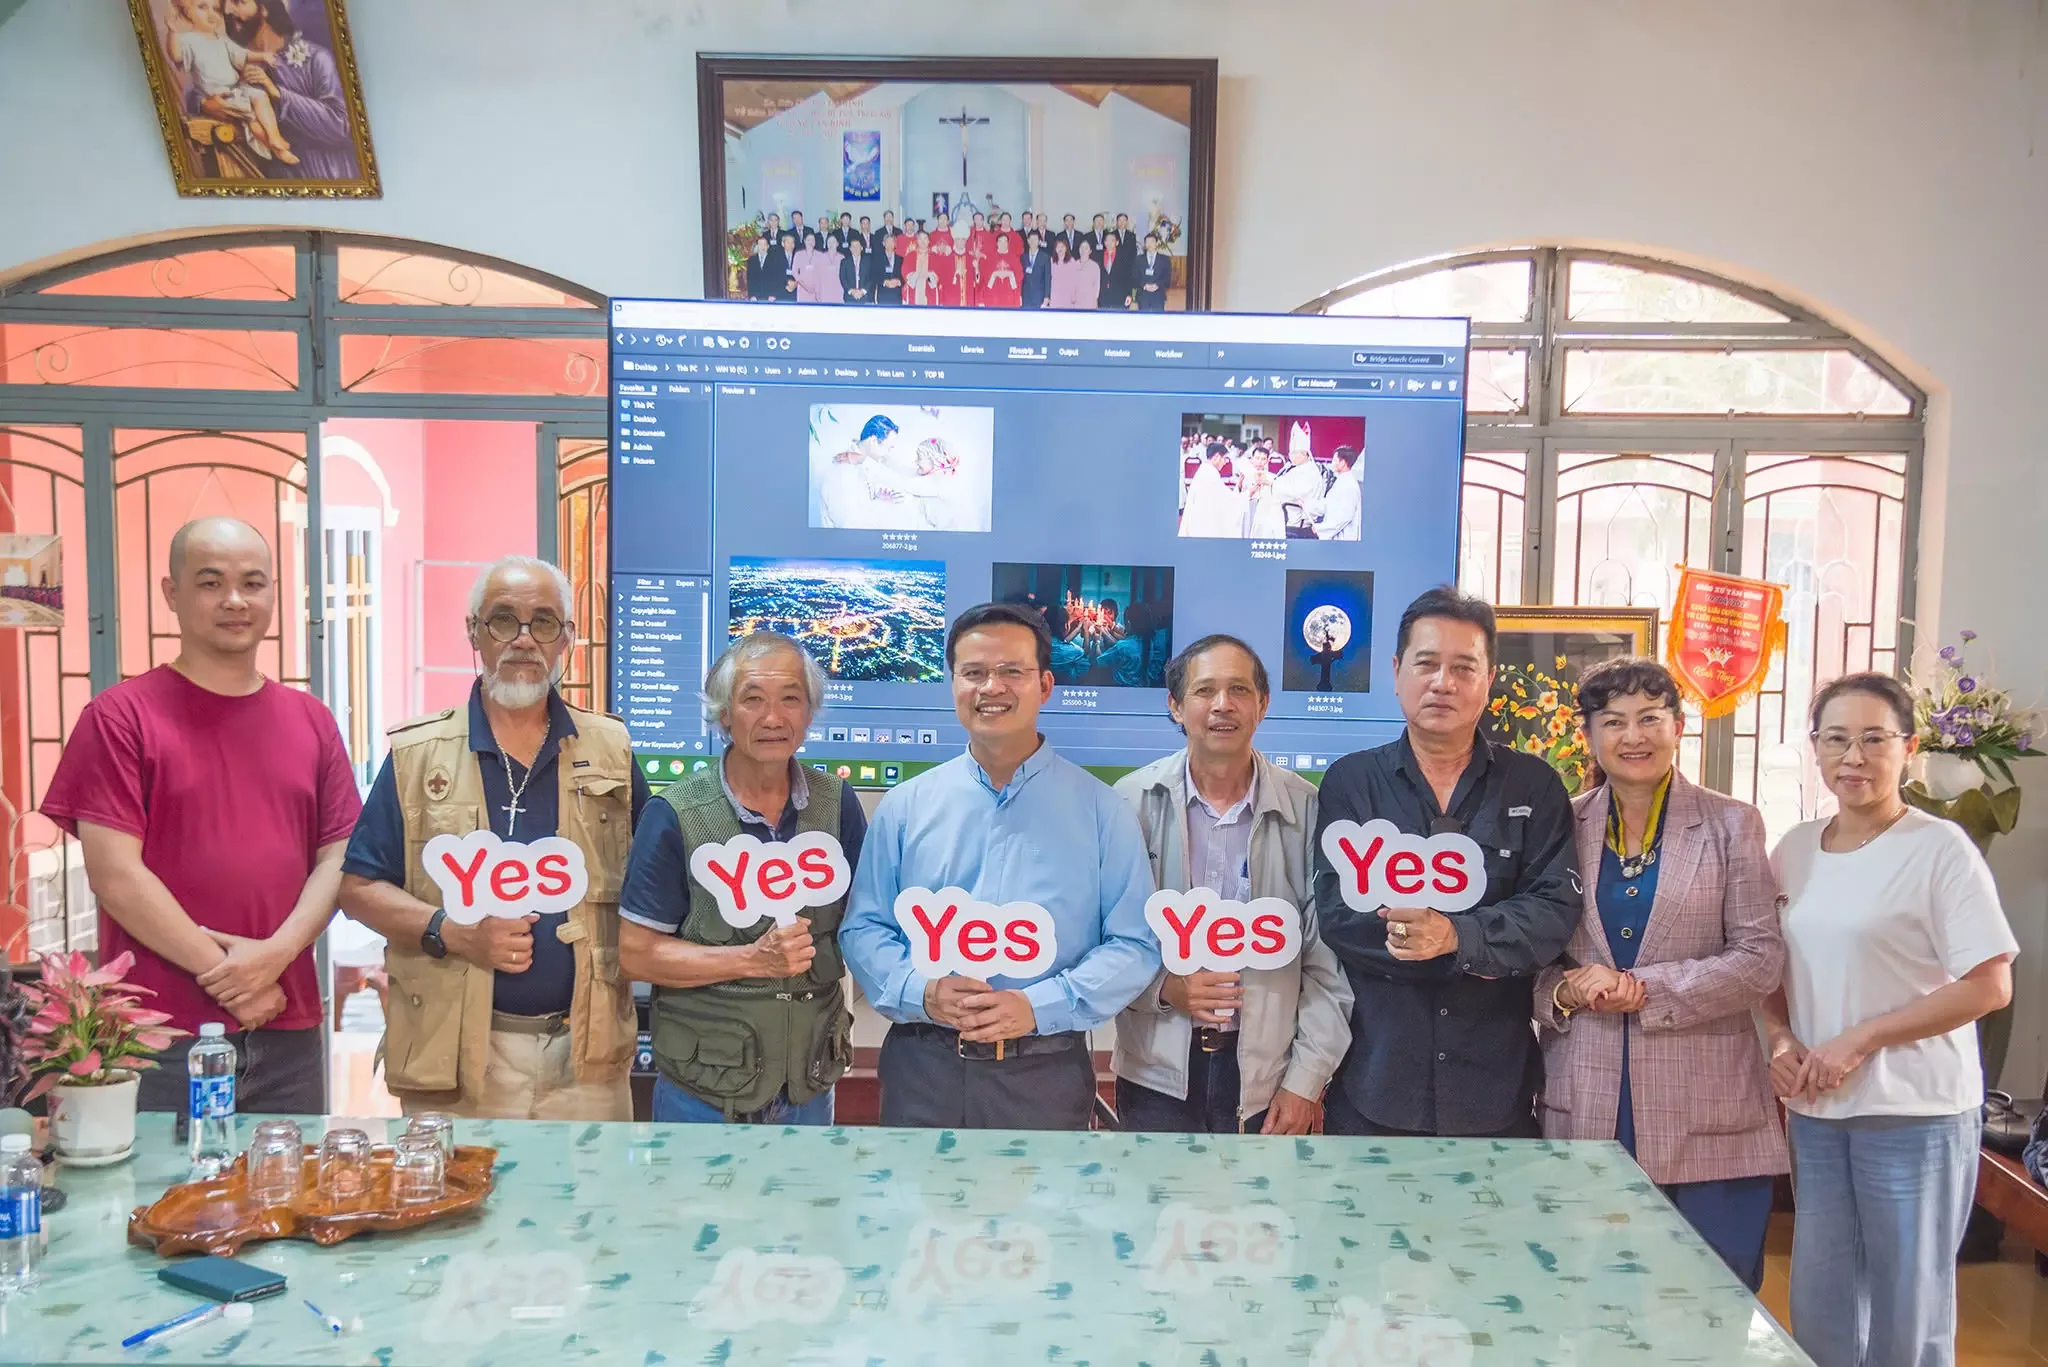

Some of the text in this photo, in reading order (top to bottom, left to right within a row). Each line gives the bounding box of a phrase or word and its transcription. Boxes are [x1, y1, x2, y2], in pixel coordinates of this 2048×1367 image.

[1059, 348, 1079, 357] Output
[1105, 349, 1130, 358] Metadata
[1155, 350, 1183, 359] Workflow
[835, 369, 858, 378] Desktop
[633, 429, 665, 438] Documents
[442, 848, 571, 906] Yes
[708, 848, 834, 910] Yes
[1340, 837, 1468, 894] Yes
[912, 905, 1040, 962] Yes
[1162, 905, 1285, 960] Yes
